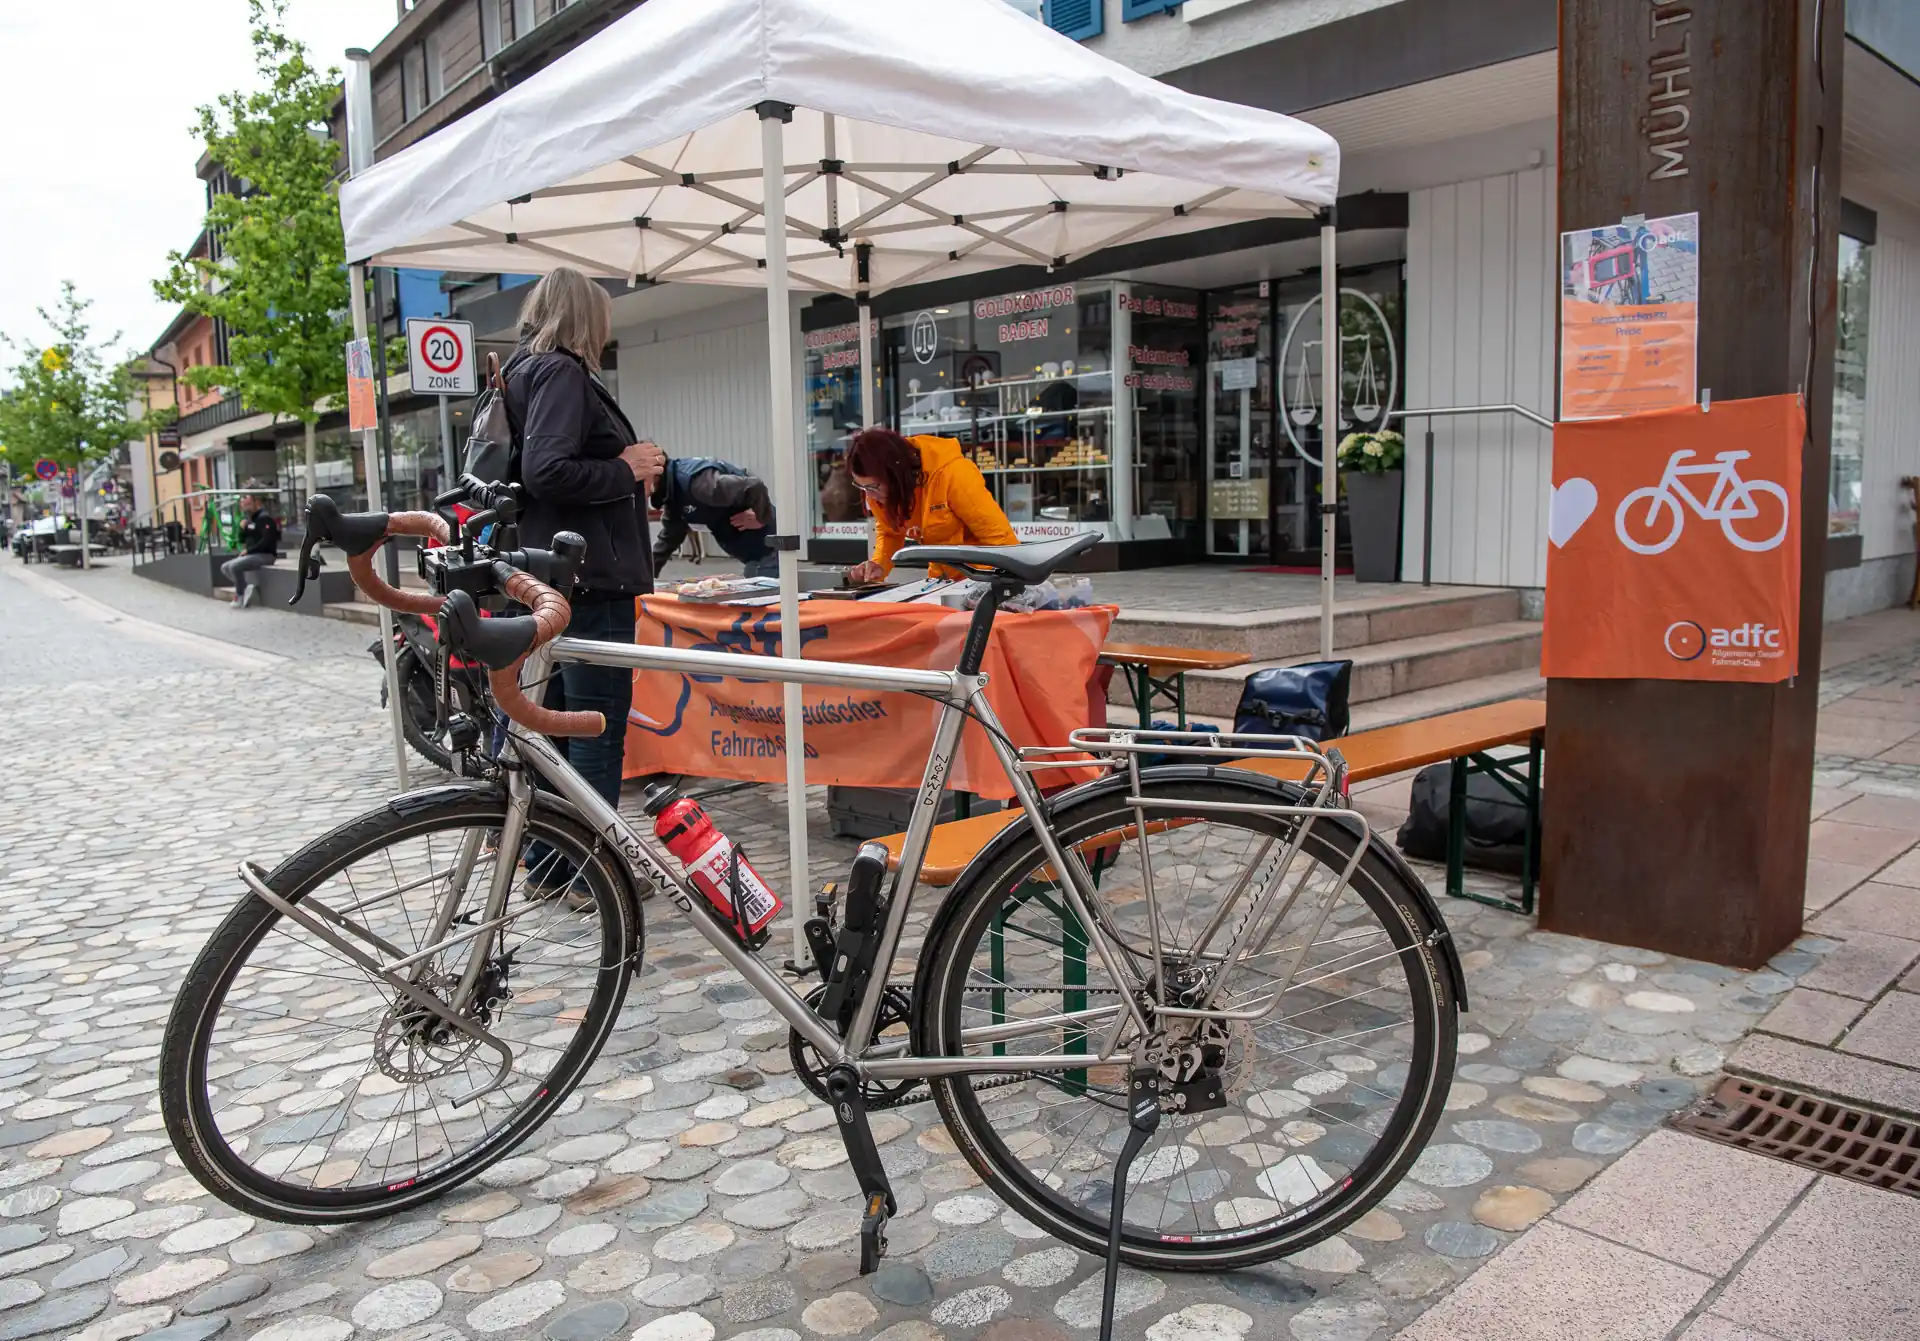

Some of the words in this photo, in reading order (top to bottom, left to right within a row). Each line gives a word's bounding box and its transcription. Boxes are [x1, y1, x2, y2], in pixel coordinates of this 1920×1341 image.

[1641, 0, 1693, 181] MÜHLT
[974, 285, 1075, 319] GOLDKONTOR
[1119, 293, 1141, 313] Pas
[1143, 295, 1161, 315] de
[805, 322, 877, 348] GOLDKONR
[999, 318, 1048, 343] BADEN
[430, 339, 454, 360] 20
[823, 350, 859, 369] BADEN
[1128, 345, 1189, 368] Paiement
[428, 376, 460, 389] ZONE
[1124, 374, 1141, 389] en
[1143, 372, 1193, 394] espèces
[1710, 622, 1780, 648] adfc
[801, 695, 888, 726] eutscher
